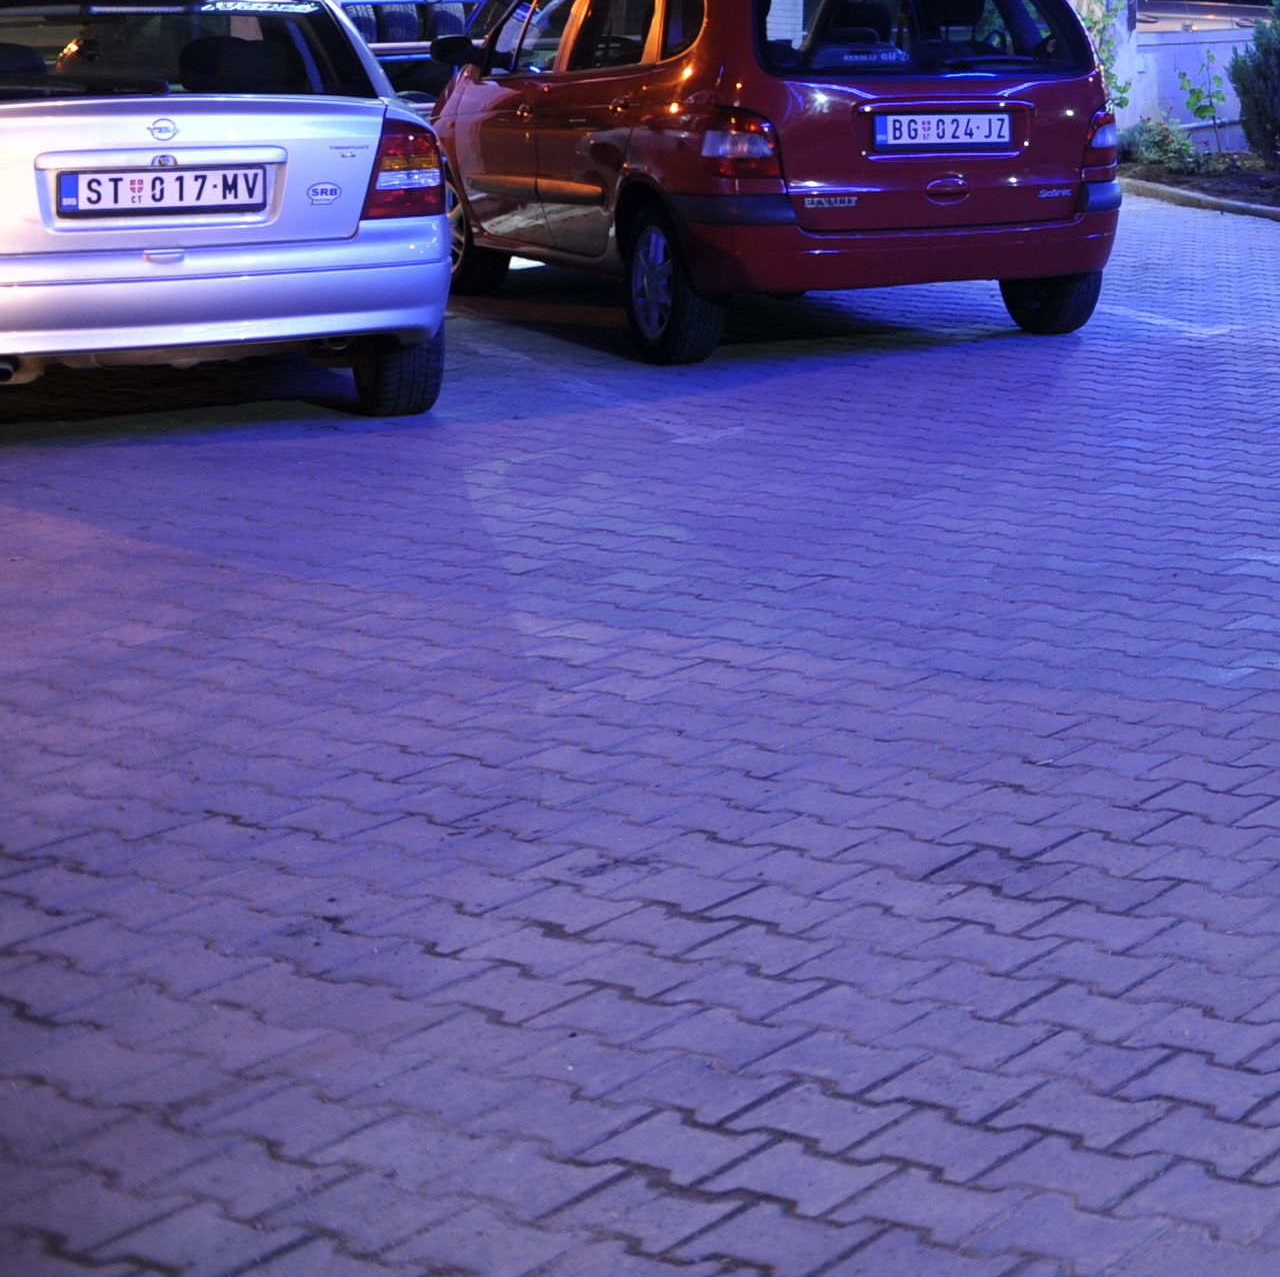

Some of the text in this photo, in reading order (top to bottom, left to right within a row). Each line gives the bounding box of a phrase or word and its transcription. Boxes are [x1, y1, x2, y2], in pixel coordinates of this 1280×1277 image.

[880, 52, 897, 60] elf
[892, 119, 918, 140] BG
[86, 178, 123, 204] ST
[312, 188, 337, 196] SRB
